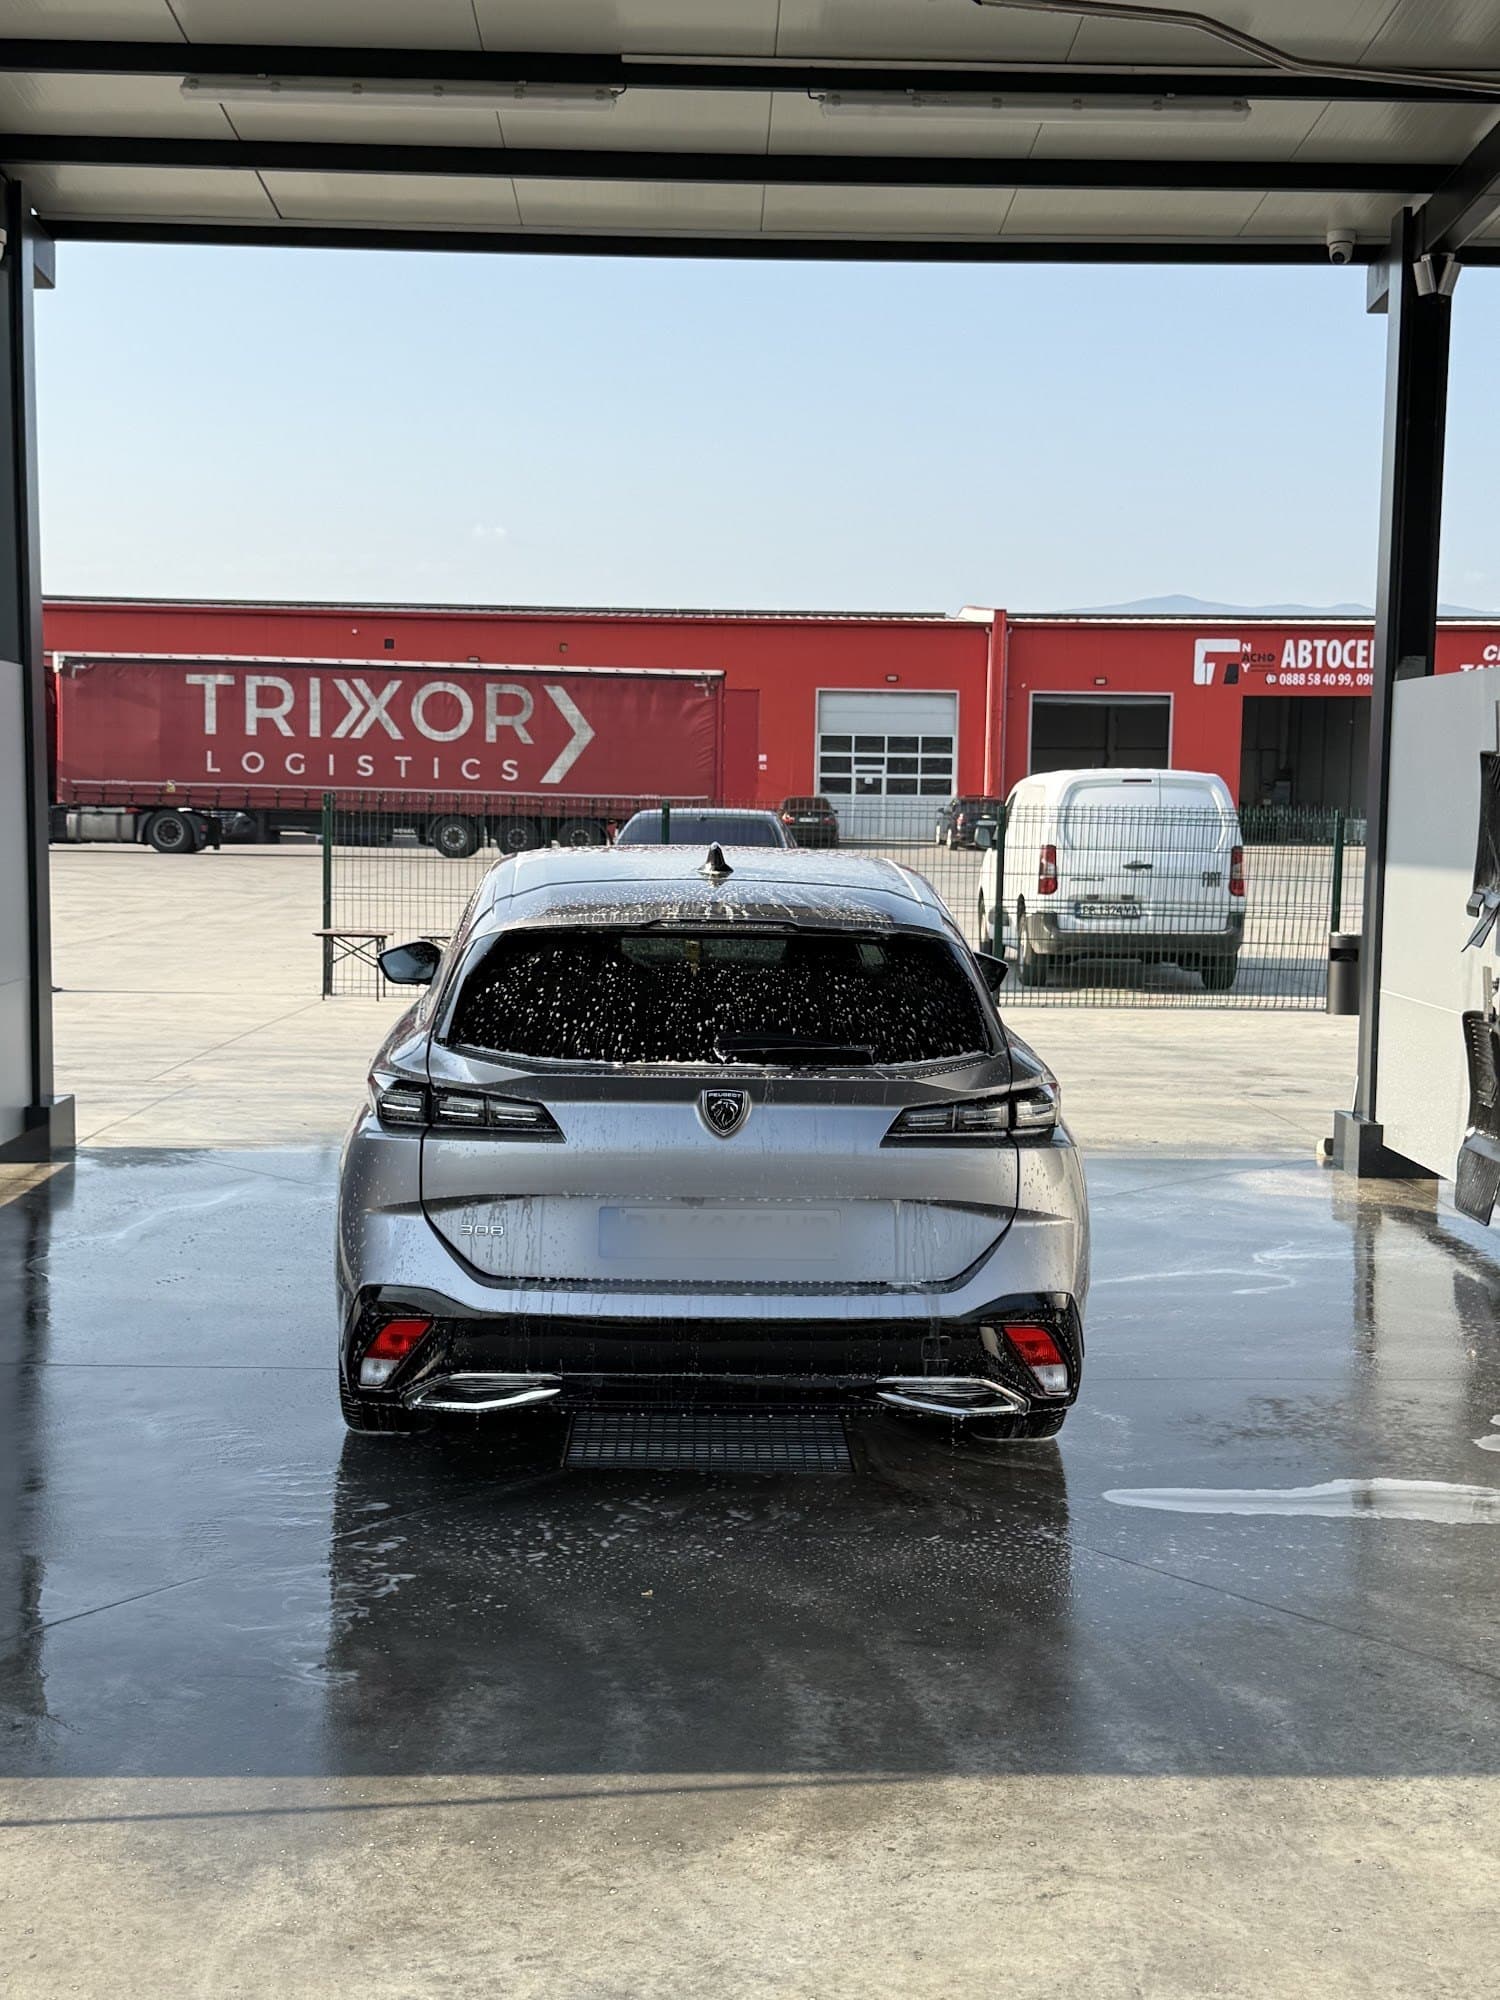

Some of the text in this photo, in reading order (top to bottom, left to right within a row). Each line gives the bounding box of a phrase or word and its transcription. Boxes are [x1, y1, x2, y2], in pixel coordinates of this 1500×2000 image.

[1279, 673, 1306, 686] 0888
[1307, 673, 1321, 686] 58
[1322, 673, 1336, 686] 40
[206, 750, 519, 781] LOGISTICS
[1202, 871, 1222, 888] FIAT
[460, 1224, 504, 1236] 308
